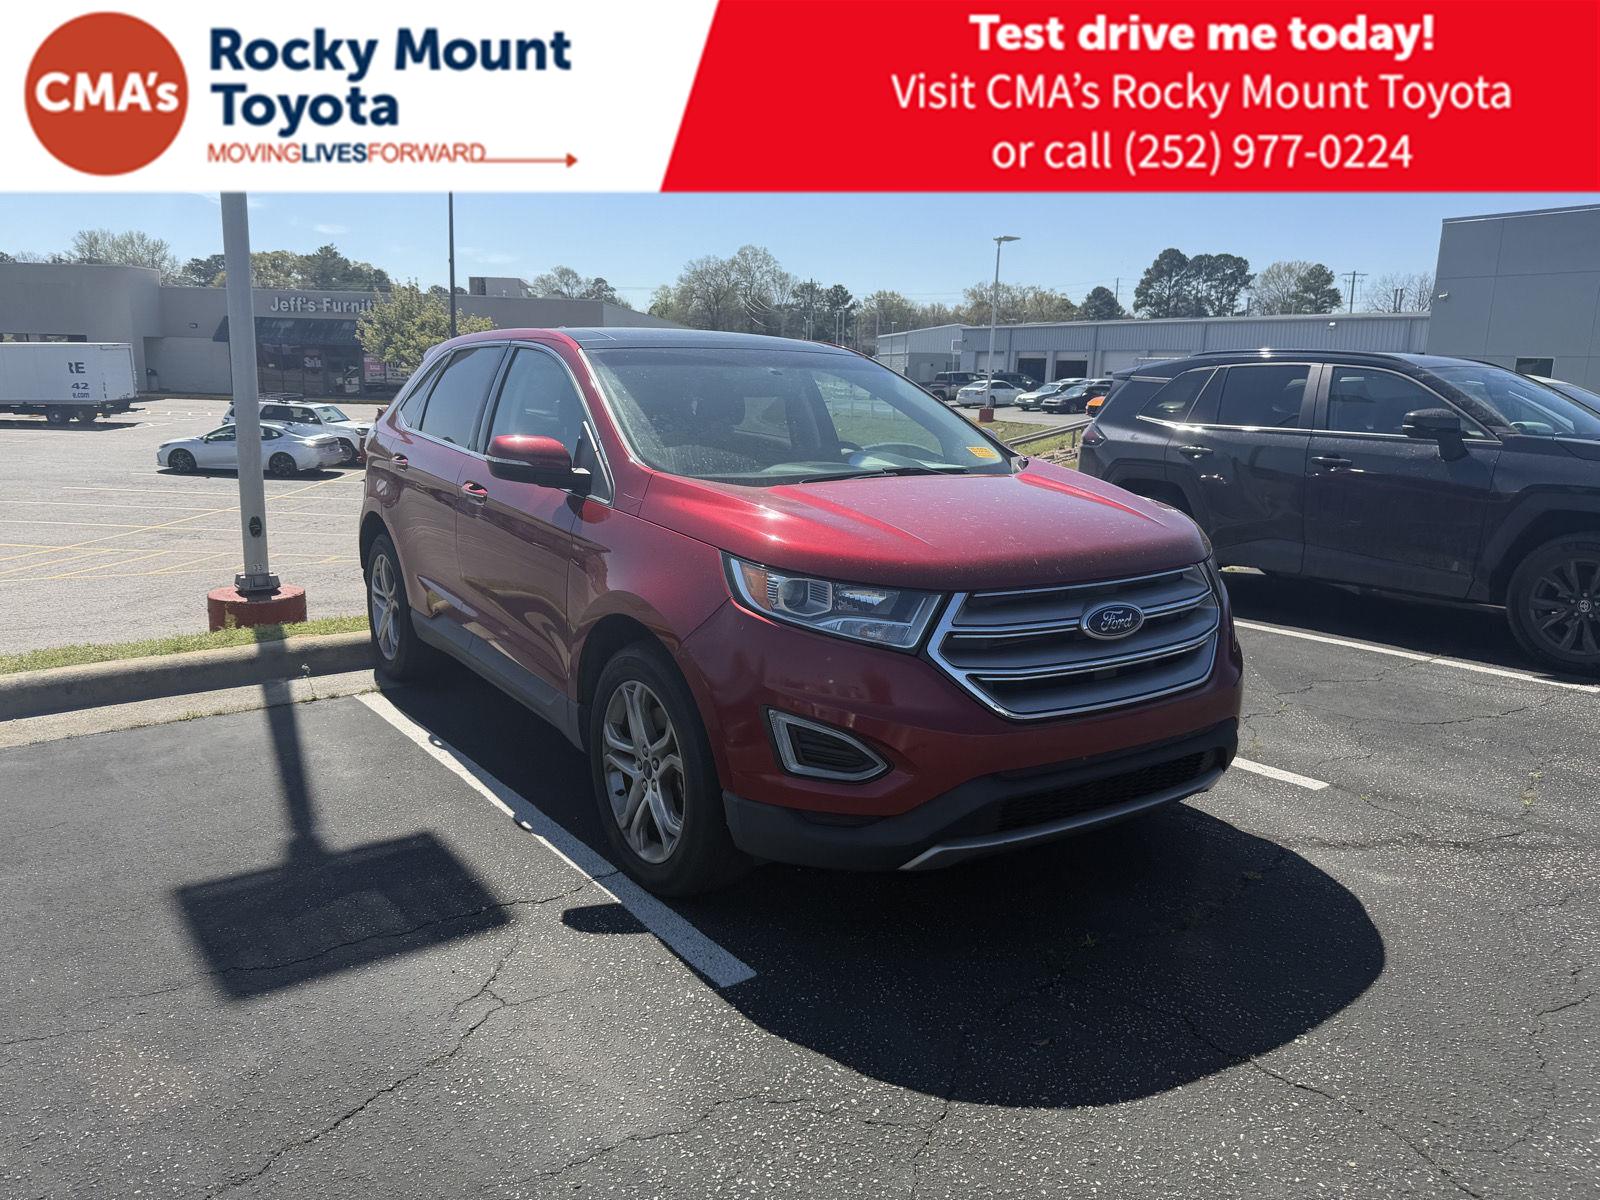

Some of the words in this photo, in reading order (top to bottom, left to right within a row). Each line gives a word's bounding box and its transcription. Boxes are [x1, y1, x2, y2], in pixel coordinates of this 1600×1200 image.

[270, 297, 316, 312] Jeff's
[322, 298, 373, 313] Furnit
[71, 382, 89, 390] 42
[1100, 609, 1132, 631] Ford
